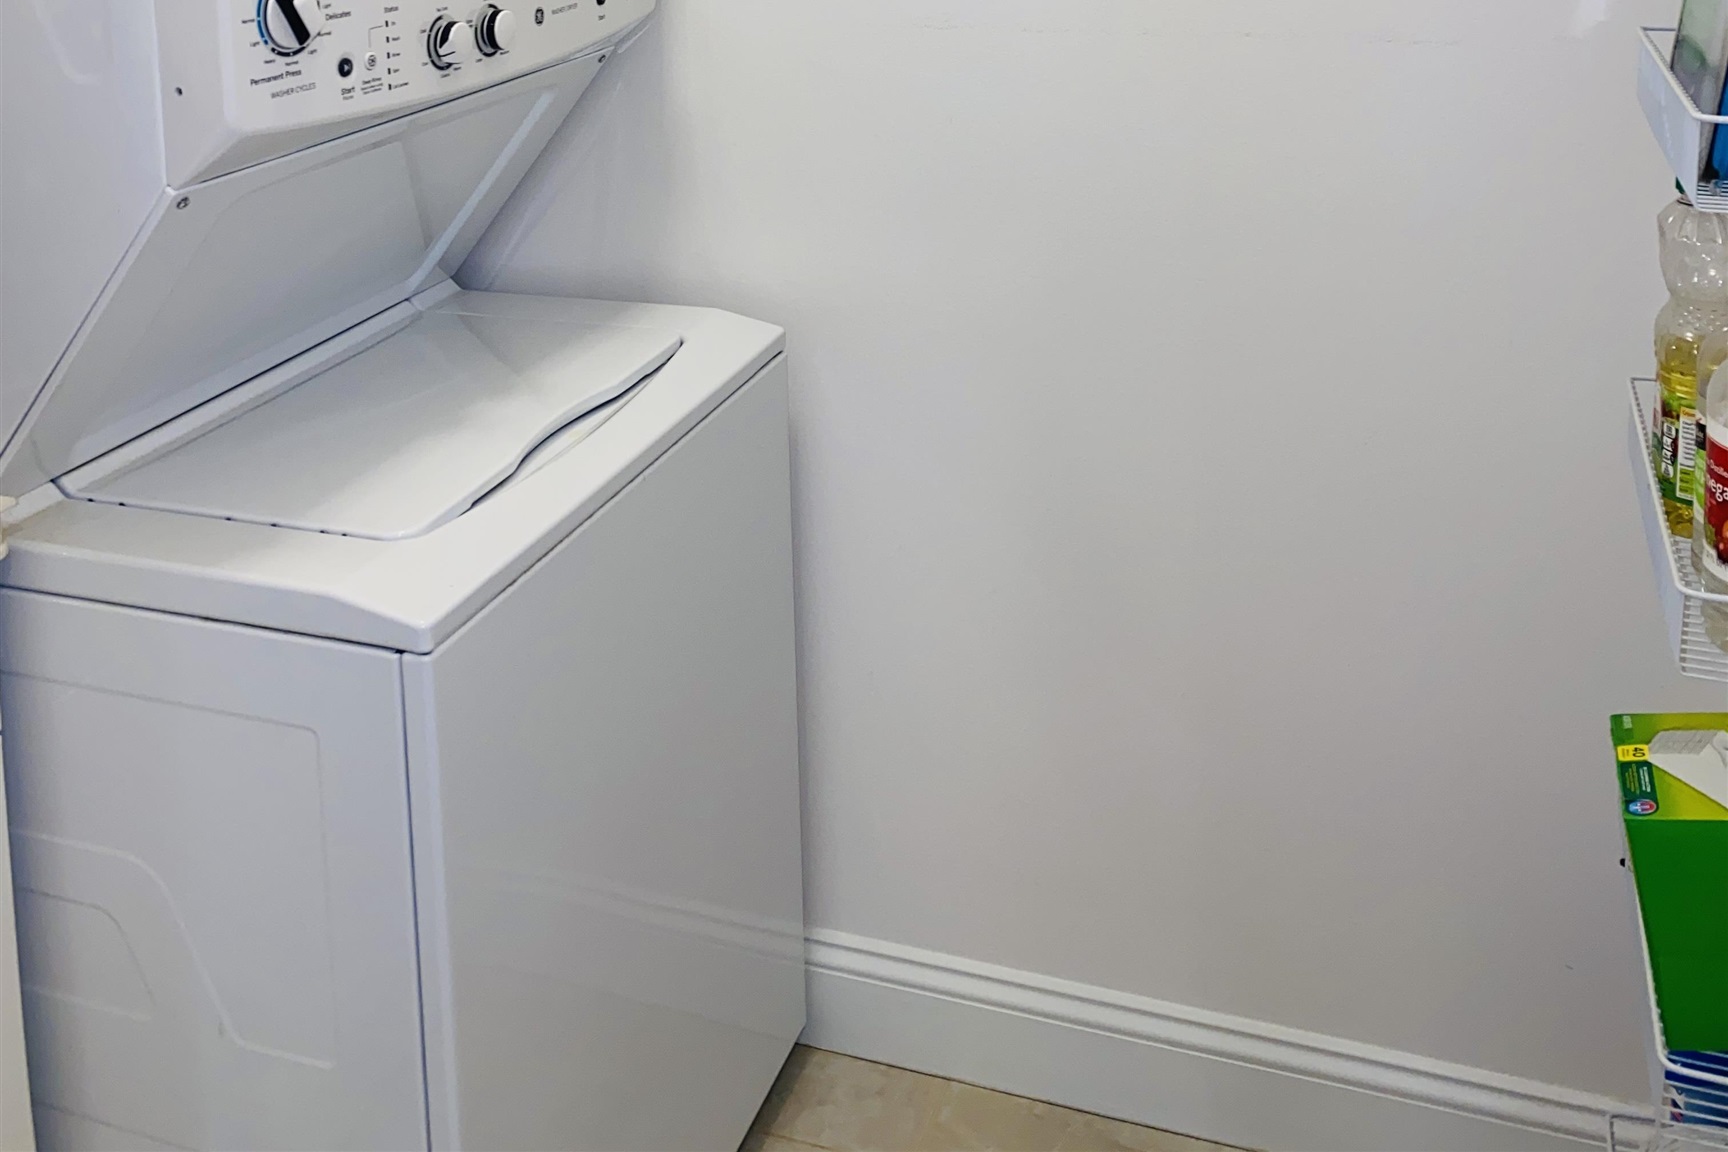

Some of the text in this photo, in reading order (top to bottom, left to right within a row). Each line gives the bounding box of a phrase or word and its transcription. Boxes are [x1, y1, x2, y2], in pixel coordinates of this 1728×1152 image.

[250, 69, 302, 86] Permanent Press
[1632, 747, 1646, 758] 40
